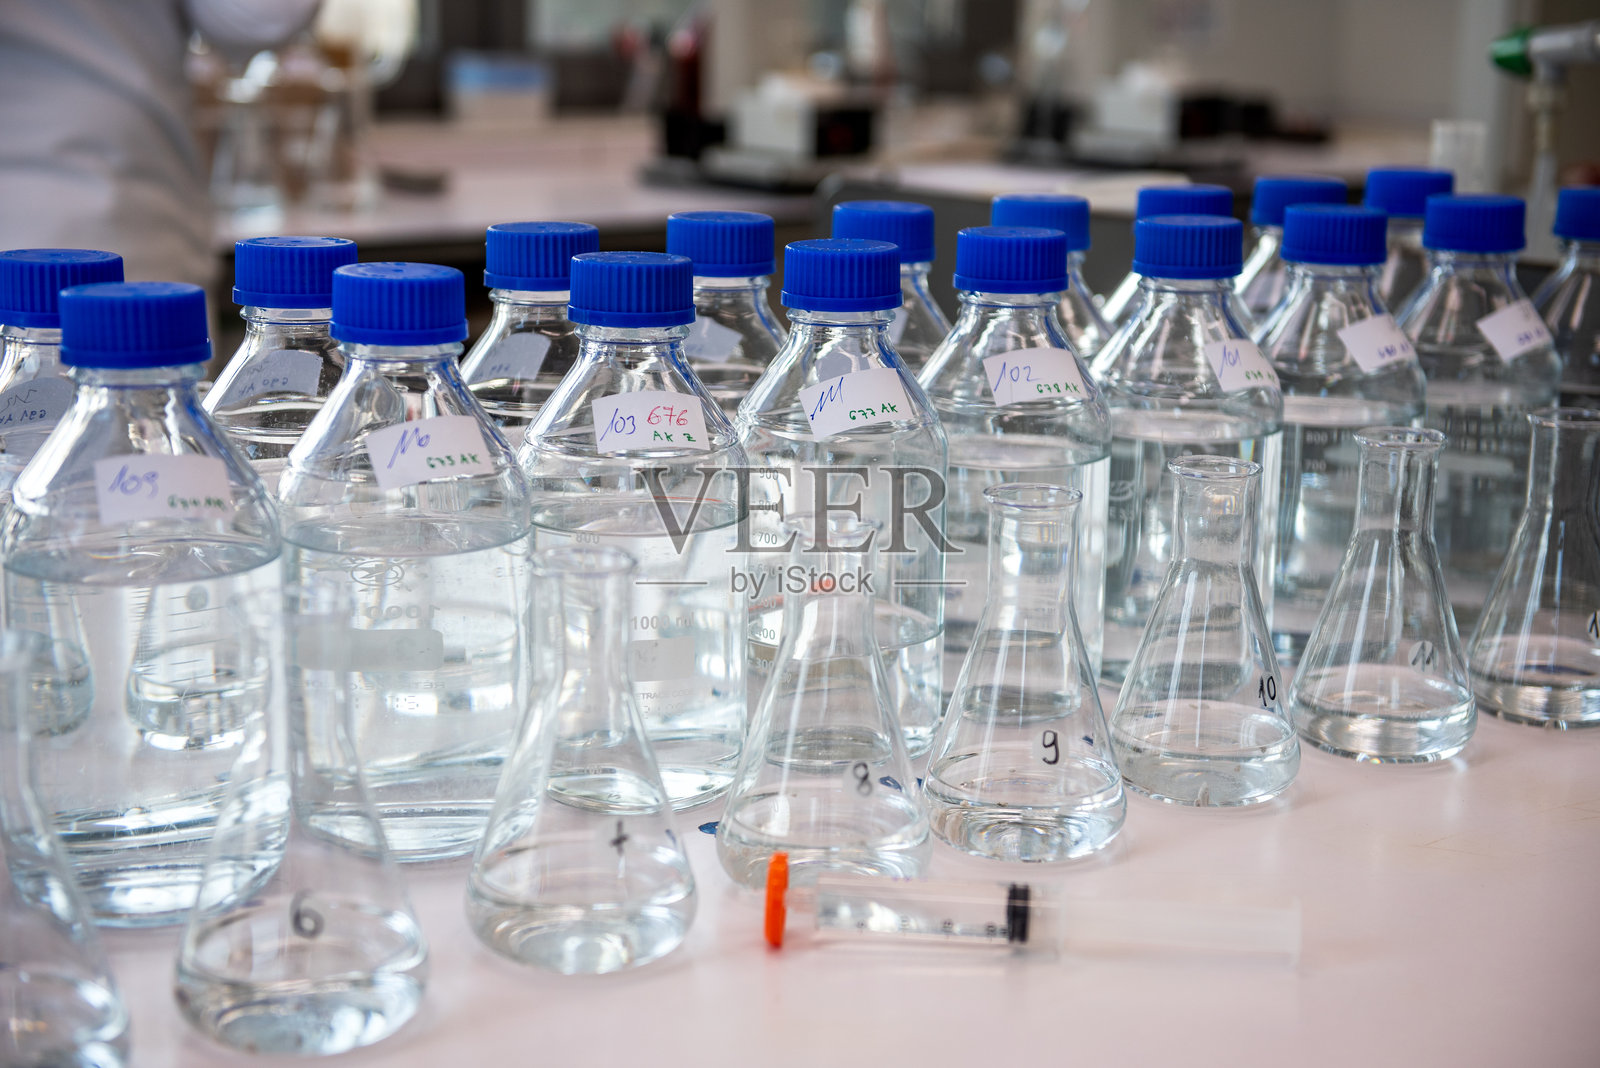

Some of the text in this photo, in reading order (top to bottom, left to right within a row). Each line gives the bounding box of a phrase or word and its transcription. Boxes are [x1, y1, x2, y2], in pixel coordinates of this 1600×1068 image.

[993, 361, 1042, 392] 102
[1219, 344, 1242, 378] 101
[1036, 382, 1062, 393] 678
[600, 405, 689, 442] 103 676
[849, 402, 899, 420] 677 AK
[653, 430, 674, 442] AK
[108, 463, 159, 499] 109
[758, 532, 778, 545] 700
[631, 611, 695, 630] 1000 ml
[1589, 610, 1600, 638] 1
[1258, 675, 1277, 707] 10
[1041, 729, 1060, 765] 9
[852, 761, 873, 797] 8
[290, 886, 325, 941] 6
